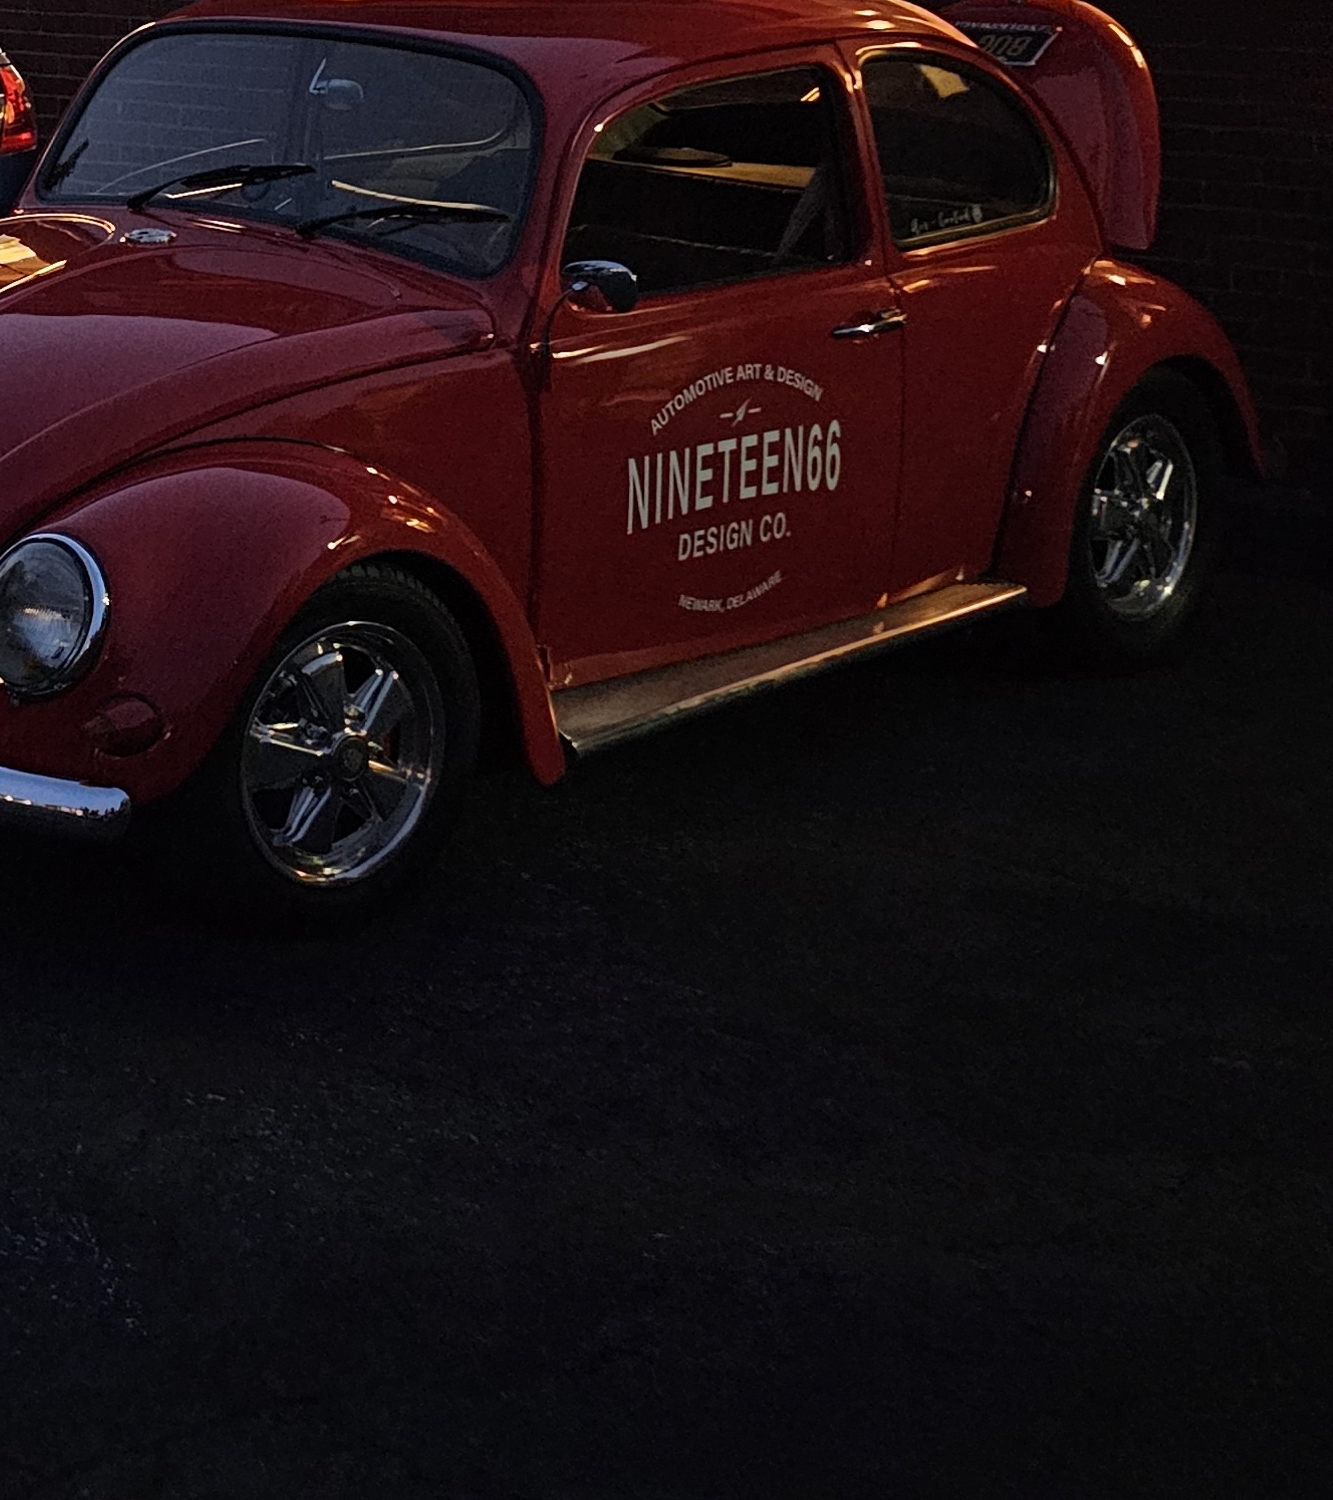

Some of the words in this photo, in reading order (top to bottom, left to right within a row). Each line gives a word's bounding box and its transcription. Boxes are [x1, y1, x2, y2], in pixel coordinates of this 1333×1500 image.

[649, 367, 734, 435] AUTOMOTIVE
[735, 363, 762, 382] ART
[763, 363, 776, 381] &
[776, 366, 824, 401] DESIGN
[627, 419, 842, 535] NINETEEN66
[677, 519, 753, 561] DESIGN
[759, 512, 792, 543] CO.
